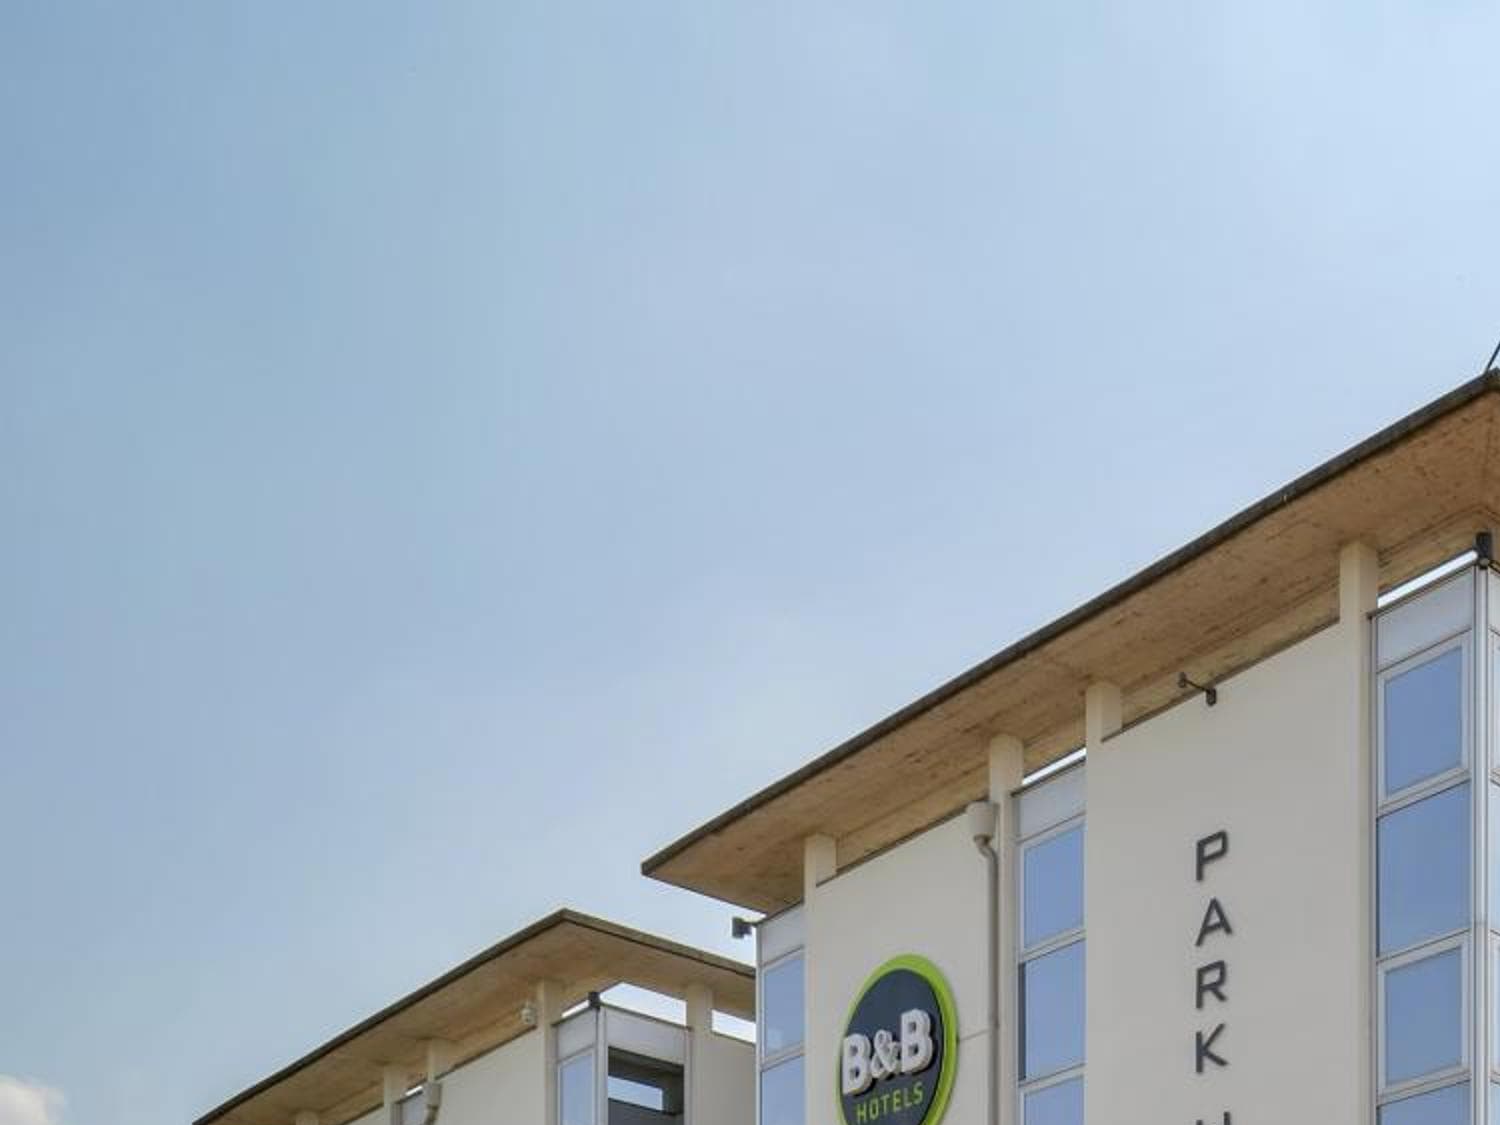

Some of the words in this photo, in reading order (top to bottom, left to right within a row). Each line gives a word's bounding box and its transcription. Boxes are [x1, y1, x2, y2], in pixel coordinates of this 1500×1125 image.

[1195, 829, 1233, 1075] PARK
[842, 1008, 935, 1096] B&B
[856, 1081, 924, 1125] HOTELS
